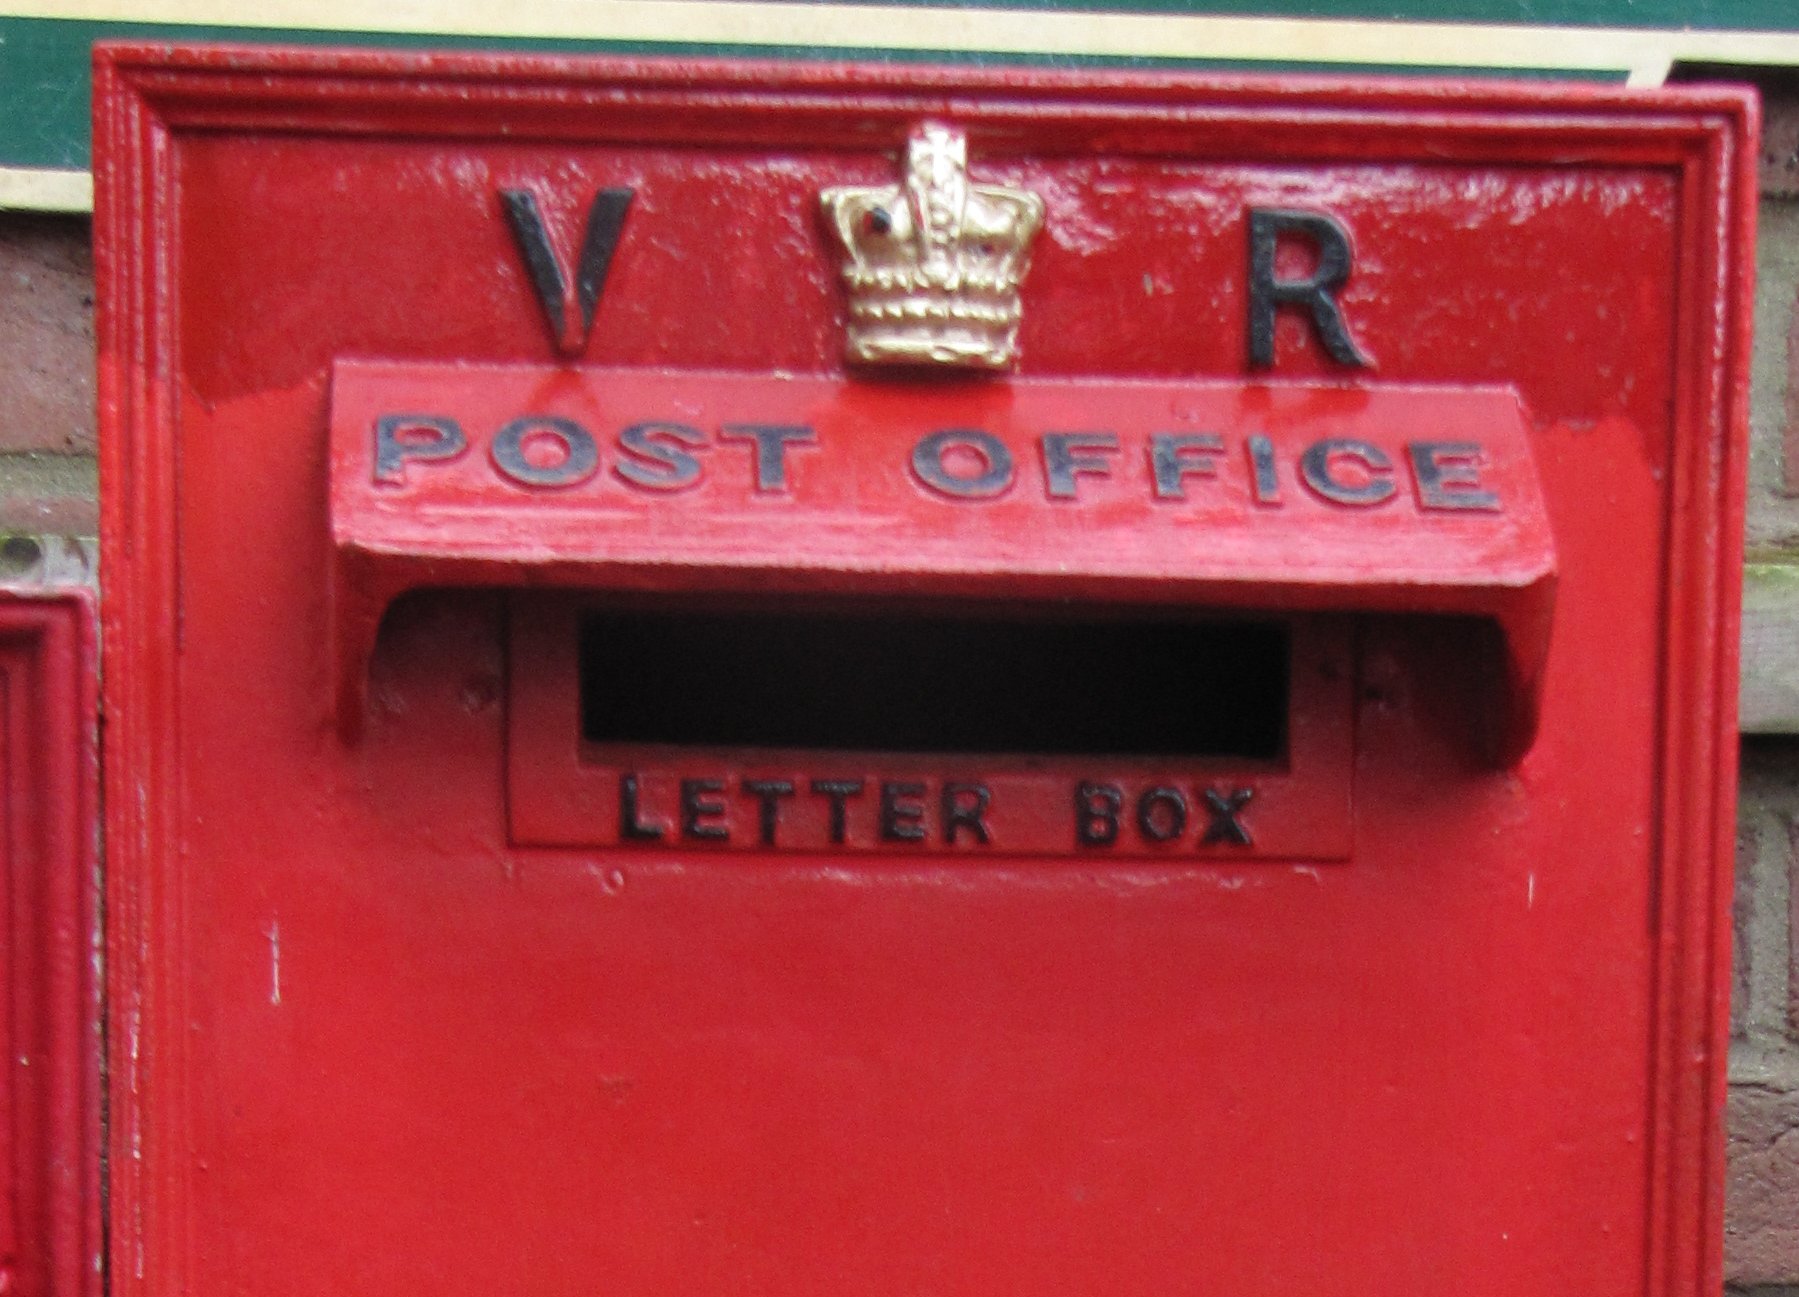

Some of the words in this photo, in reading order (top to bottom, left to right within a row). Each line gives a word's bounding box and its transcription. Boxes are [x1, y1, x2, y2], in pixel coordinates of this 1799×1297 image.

[502, 187, 634, 355] V
[1246, 204, 1374, 369] R
[371, 414, 816, 492] POST
[910, 428, 1501, 512] OFFICE
[617, 775, 994, 848] LETTER
[1074, 784, 1257, 848] BOX
